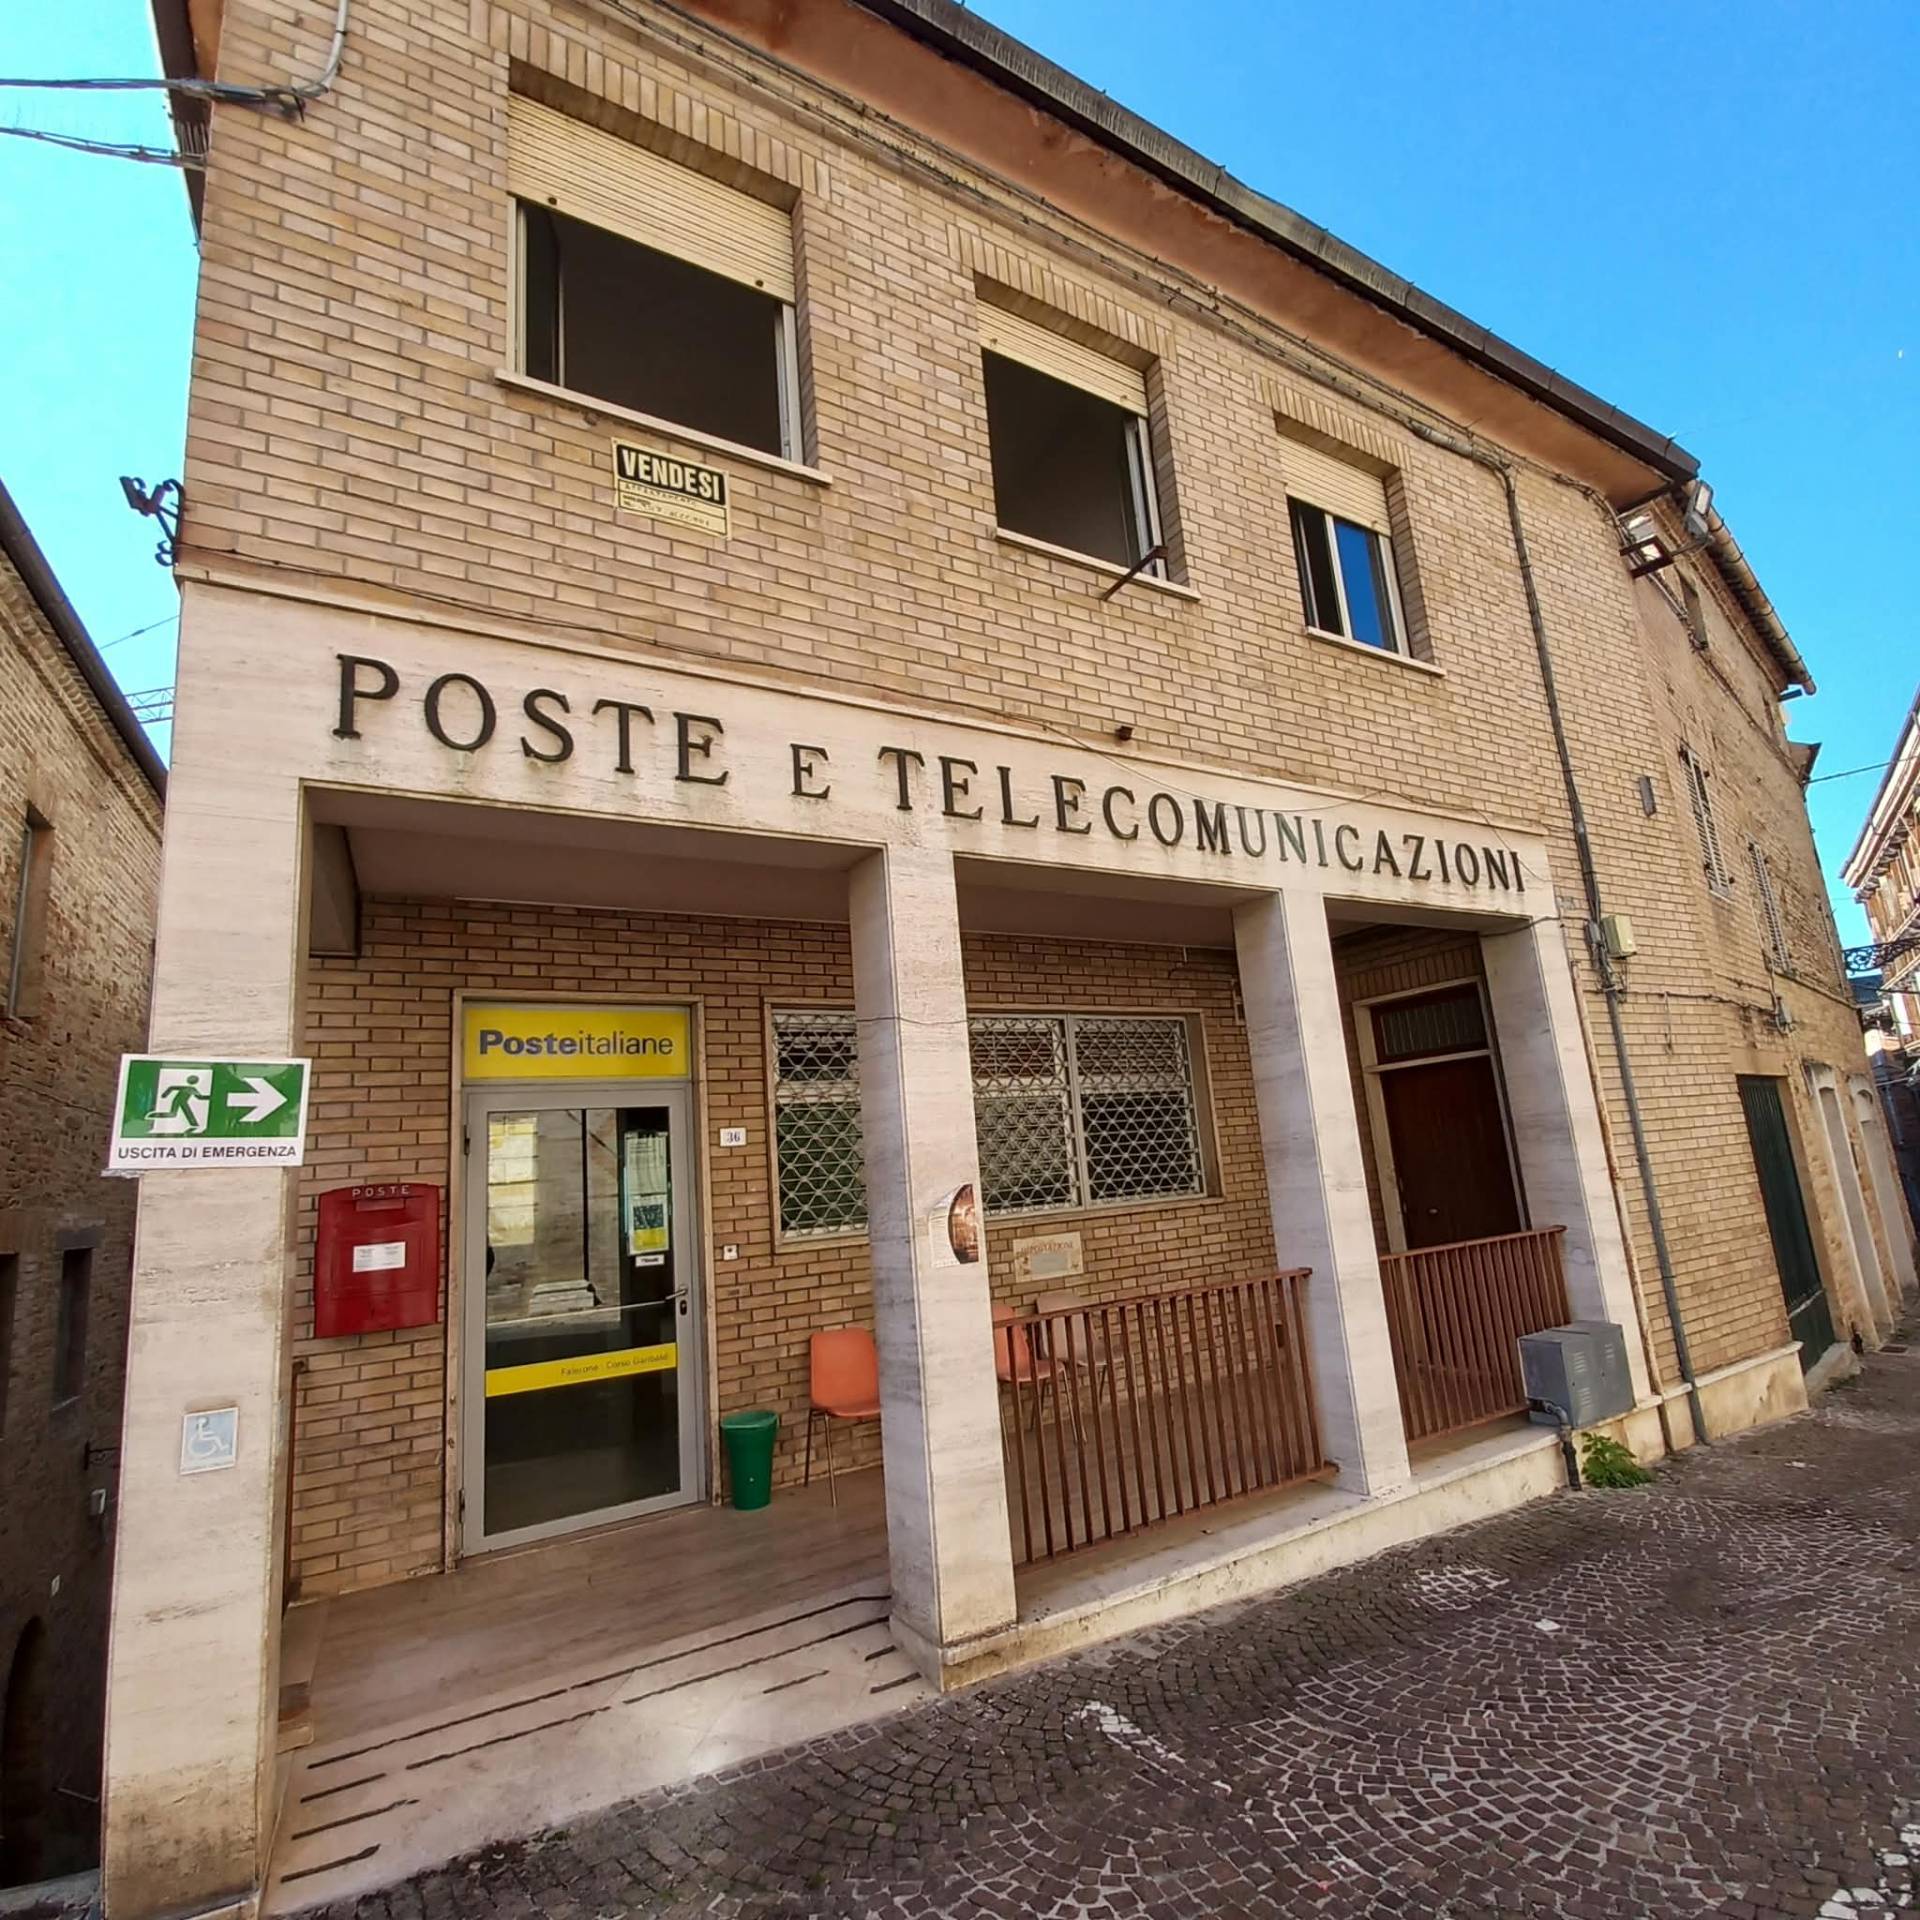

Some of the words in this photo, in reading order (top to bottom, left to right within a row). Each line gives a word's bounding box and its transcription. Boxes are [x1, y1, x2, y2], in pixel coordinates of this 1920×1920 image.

[621, 448, 721, 502] VENDESI
[332, 653, 729, 786] POSTE
[790, 743, 831, 800] E
[877, 746, 1525, 893] TELECOMUNICAZIONI
[118, 1147, 175, 1160] USCITA
[181, 1147, 198, 1159] DI
[201, 1146, 297, 1159] EMERGENZA
[352, 1184, 411, 1198] POSTE
